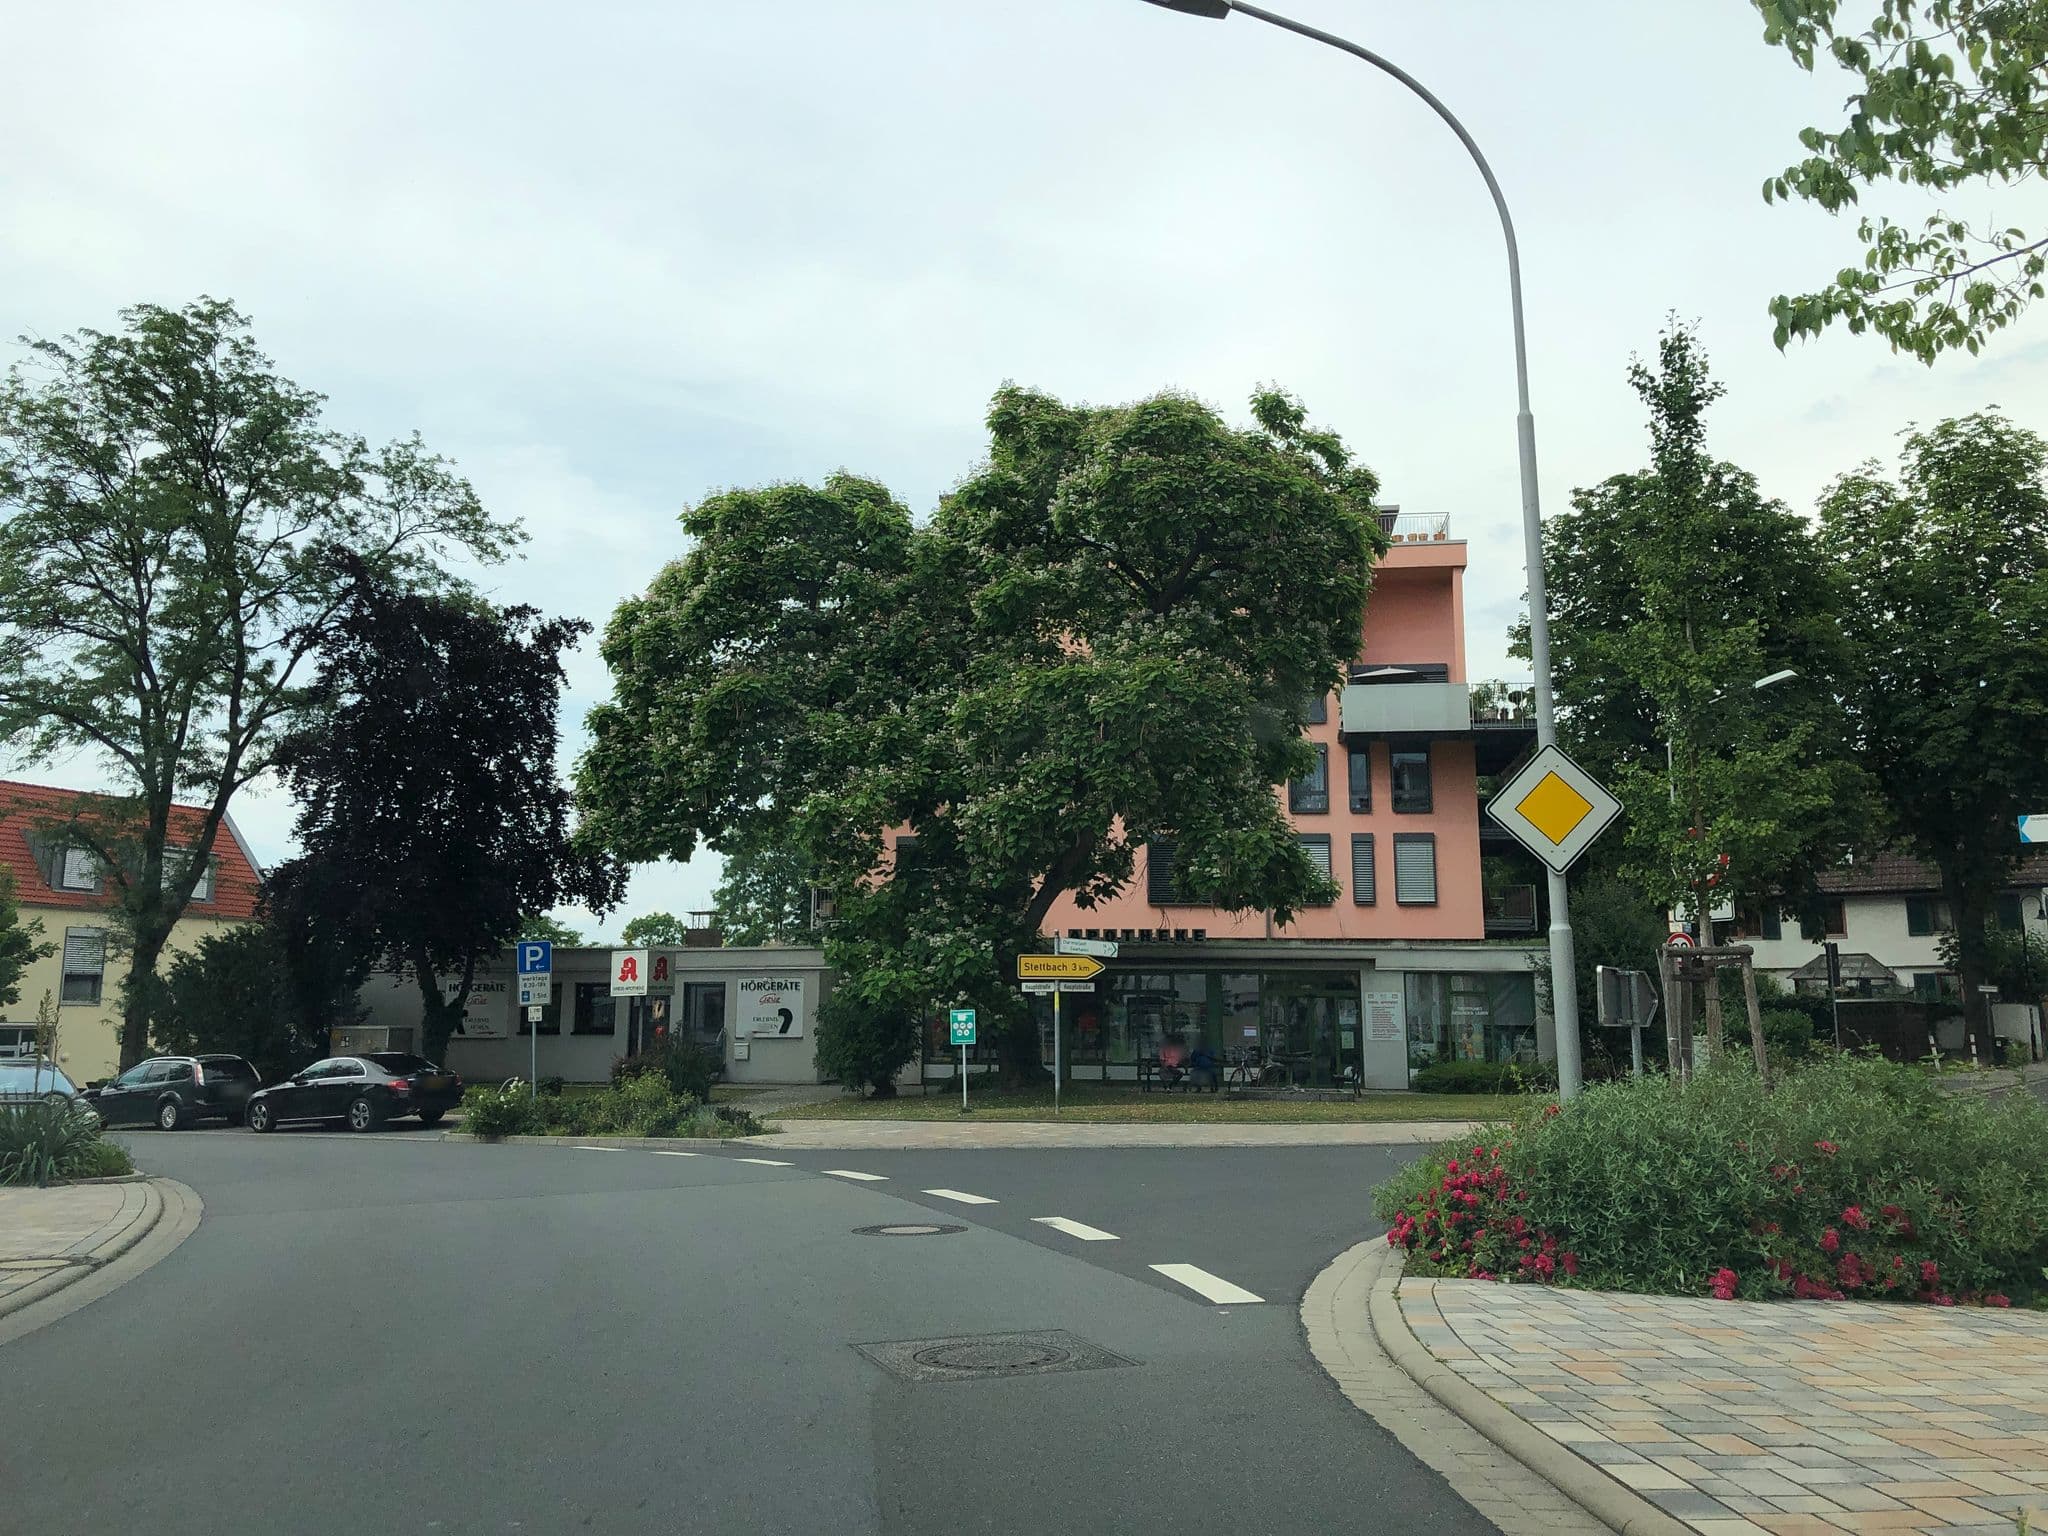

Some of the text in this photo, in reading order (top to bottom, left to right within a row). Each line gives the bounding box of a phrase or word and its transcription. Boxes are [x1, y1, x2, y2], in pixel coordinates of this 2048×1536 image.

[1069, 929, 1206, 942] APOTHEKE
[526, 946, 543, 970] P
[1024, 962, 1067, 971] Stettbach
[1071, 962, 1077, 971] 3
[740, 979, 801, 992] HÖRGERÄTE
